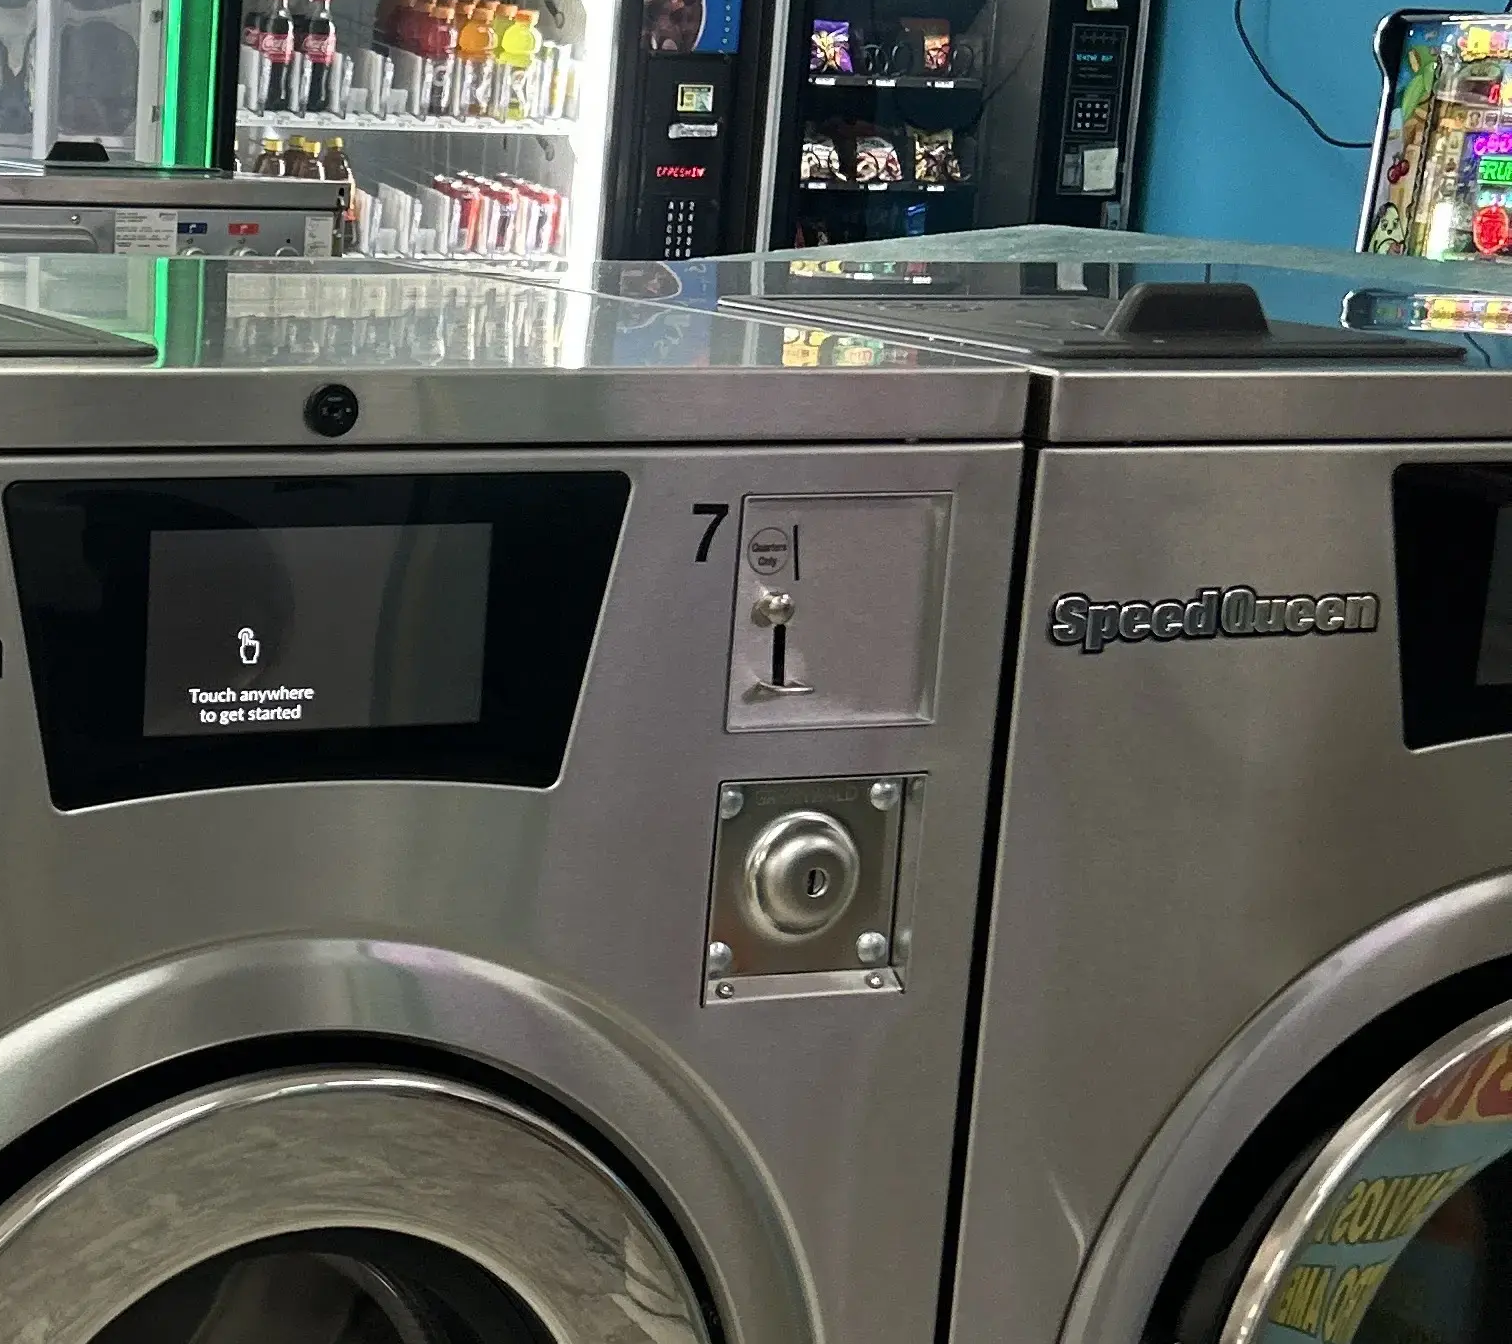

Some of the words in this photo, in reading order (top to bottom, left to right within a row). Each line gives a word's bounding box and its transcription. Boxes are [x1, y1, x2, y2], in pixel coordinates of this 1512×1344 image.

[692, 503, 729, 563] 7
[1049, 587, 1221, 654] Speed
[1220, 585, 1381, 638] Queen
[188, 687, 238, 704] Touch
[239, 685, 316, 704] anywhere
[199, 708, 217, 723] to
[219, 707, 246, 725] get
[247, 704, 302, 721] started
